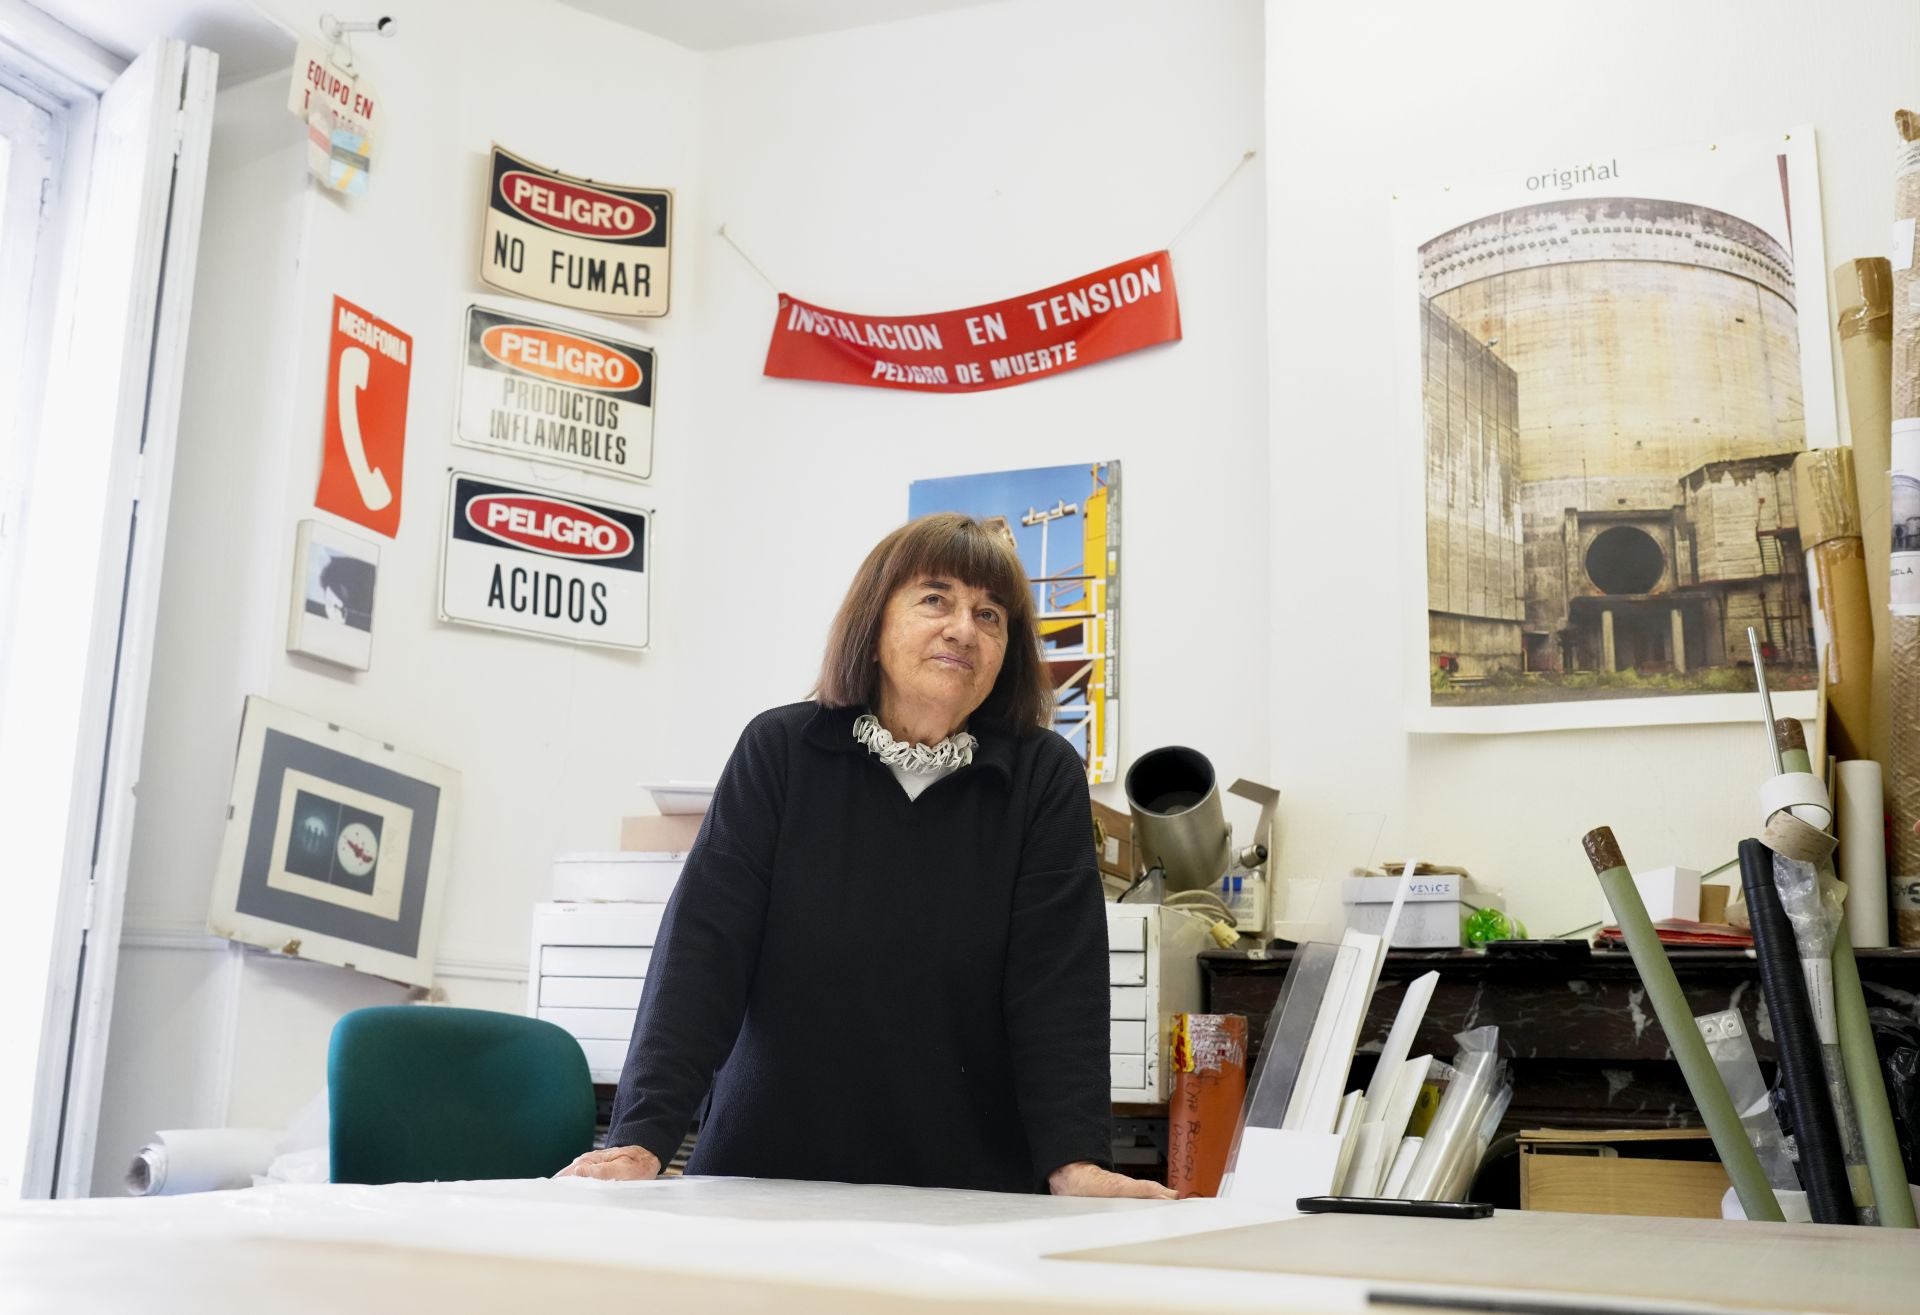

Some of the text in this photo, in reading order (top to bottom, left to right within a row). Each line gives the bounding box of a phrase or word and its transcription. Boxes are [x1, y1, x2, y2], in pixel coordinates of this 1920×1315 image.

[354, 93, 374, 120] EN
[1526, 158, 1620, 191] original
[513, 178, 636, 231] PELIGRO
[493, 230, 651, 298] NO FUMAR
[787, 264, 1162, 351] INSTALACION EN TENSION
[338, 306, 408, 367] MEGAFONIA
[500, 332, 625, 384] PELIGRO
[871, 340, 1078, 385] PELIGRO DE MUERTE
[502, 377, 620, 431] PRODUCTOS
[489, 408, 627, 466] INFLAMABLES
[487, 502, 618, 552] PELIGRO
[487, 563, 608, 627] ACIDOS
